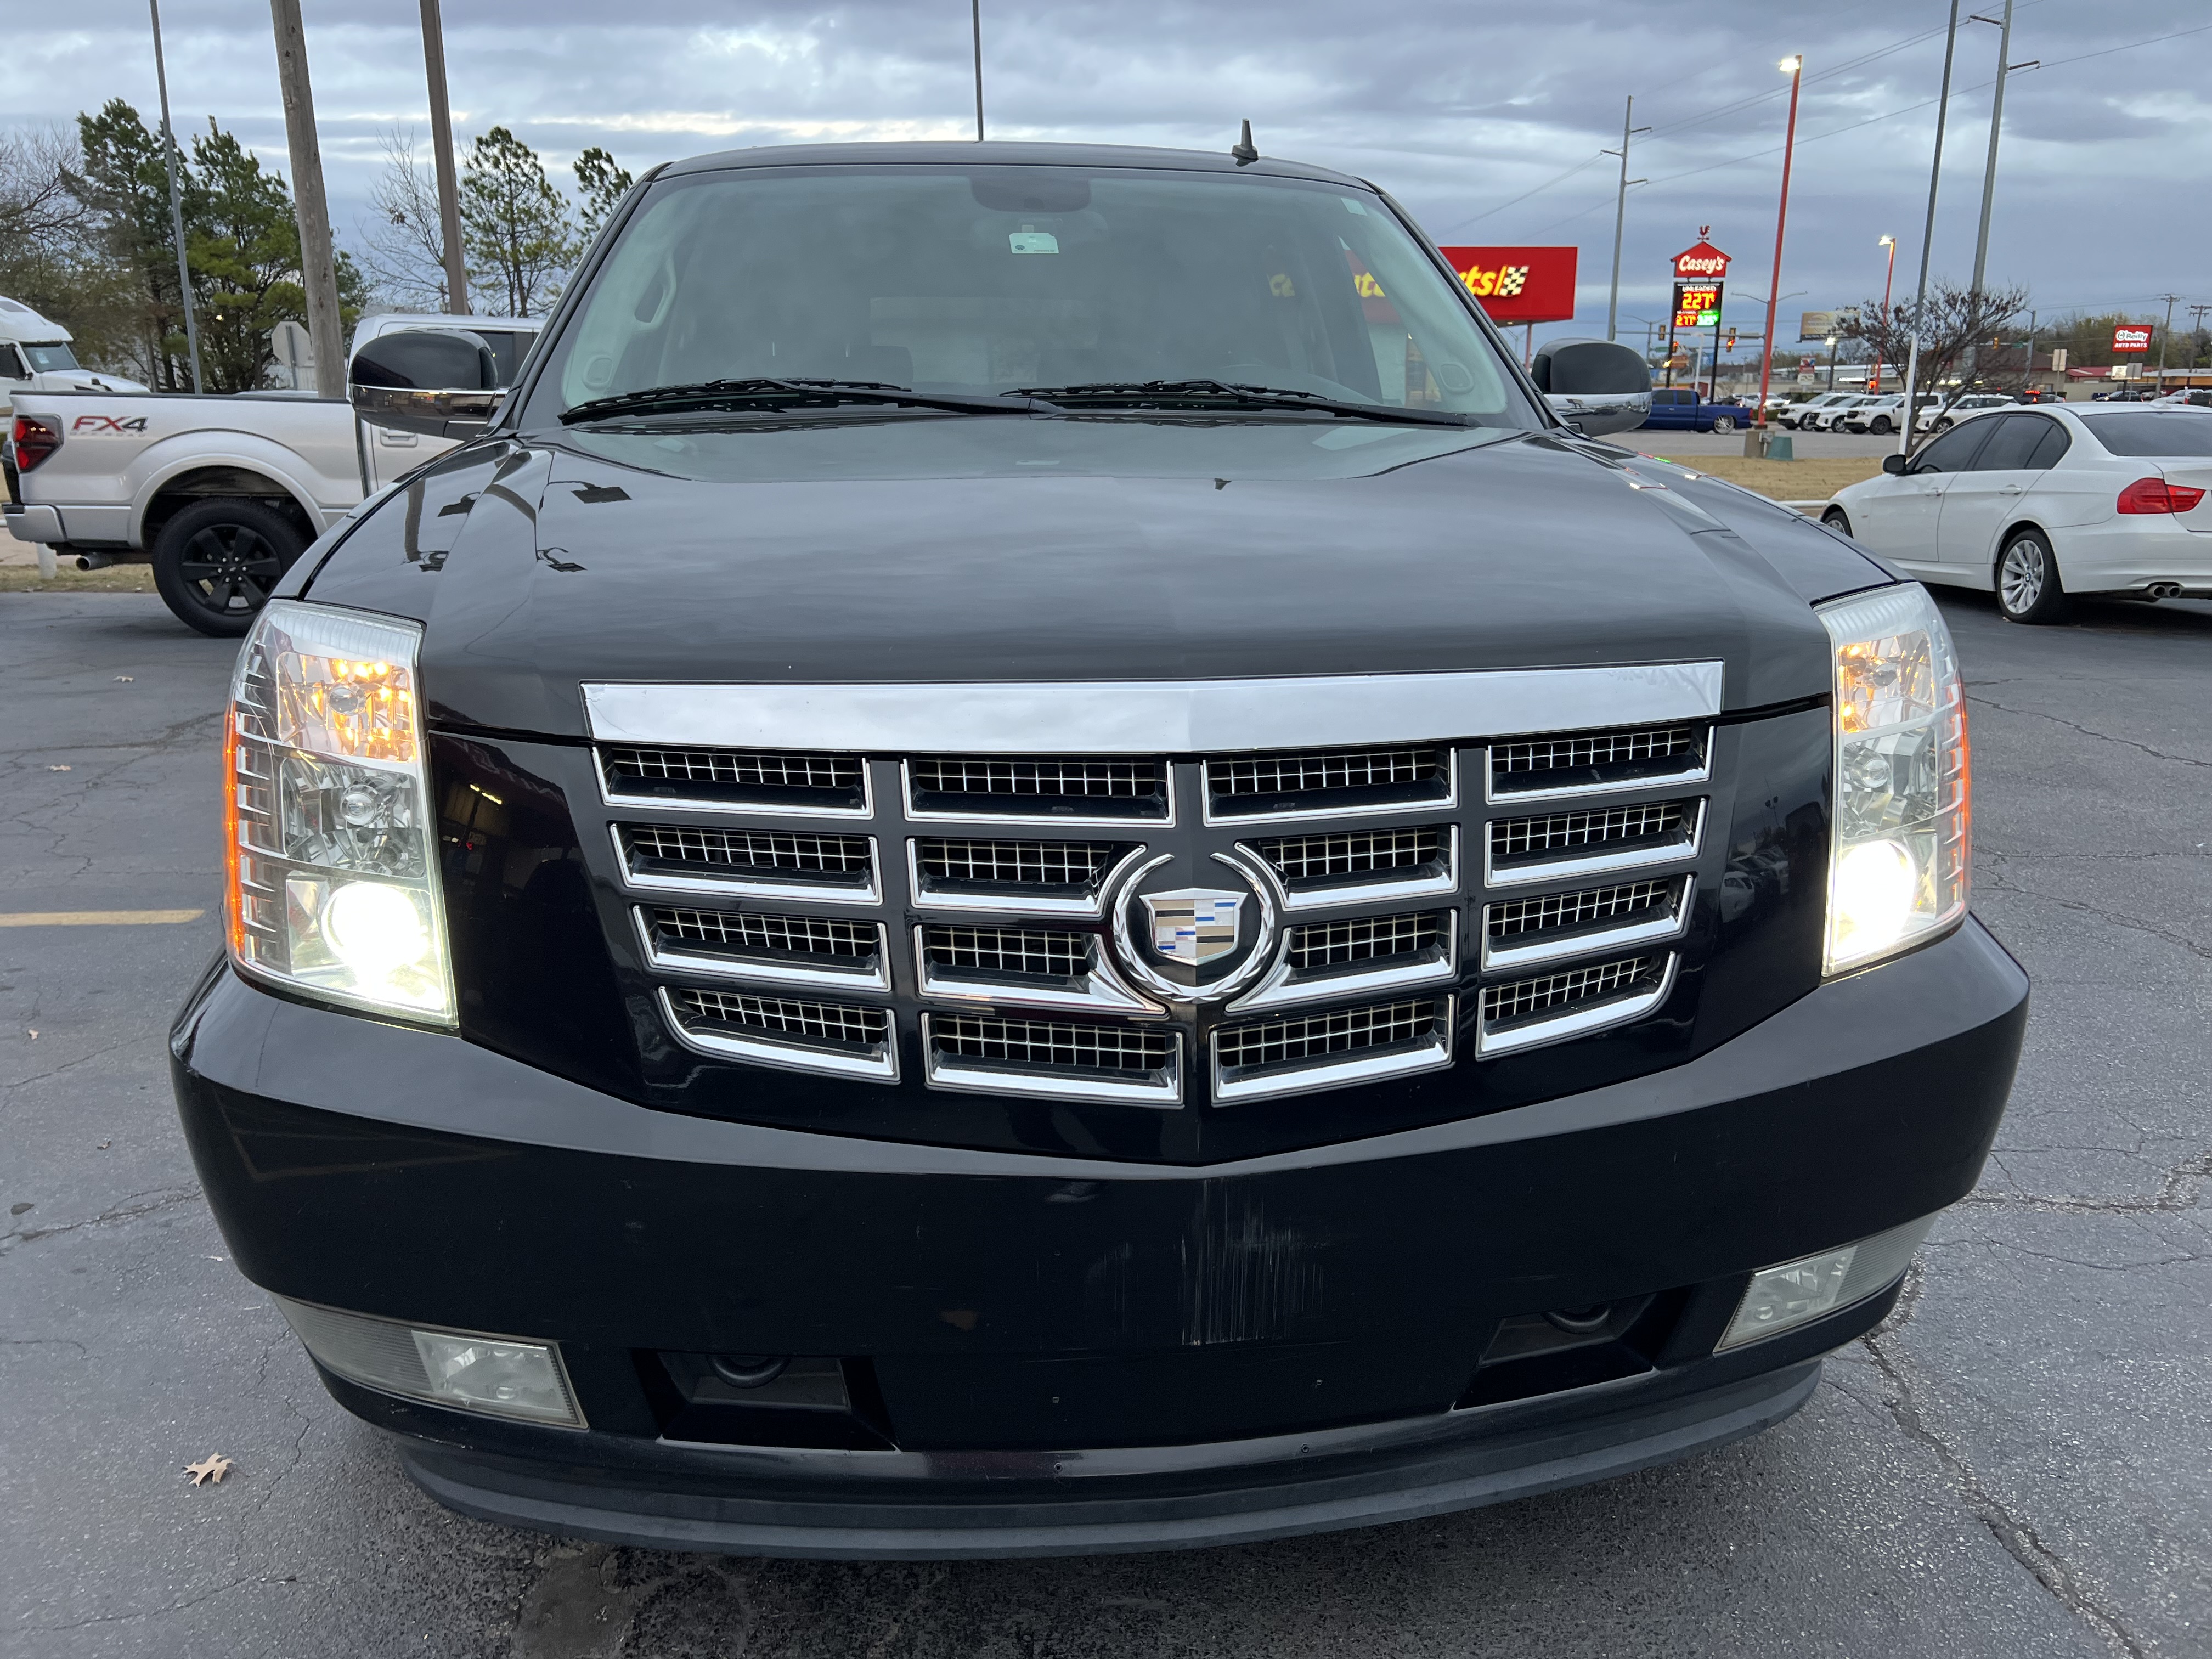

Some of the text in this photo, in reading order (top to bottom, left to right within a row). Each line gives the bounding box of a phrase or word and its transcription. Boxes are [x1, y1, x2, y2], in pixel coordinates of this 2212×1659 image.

[1679, 255, 1724, 274] Casey's
[2117, 331, 2147, 340] O'Reilly
[71, 415, 148, 432] FX4
